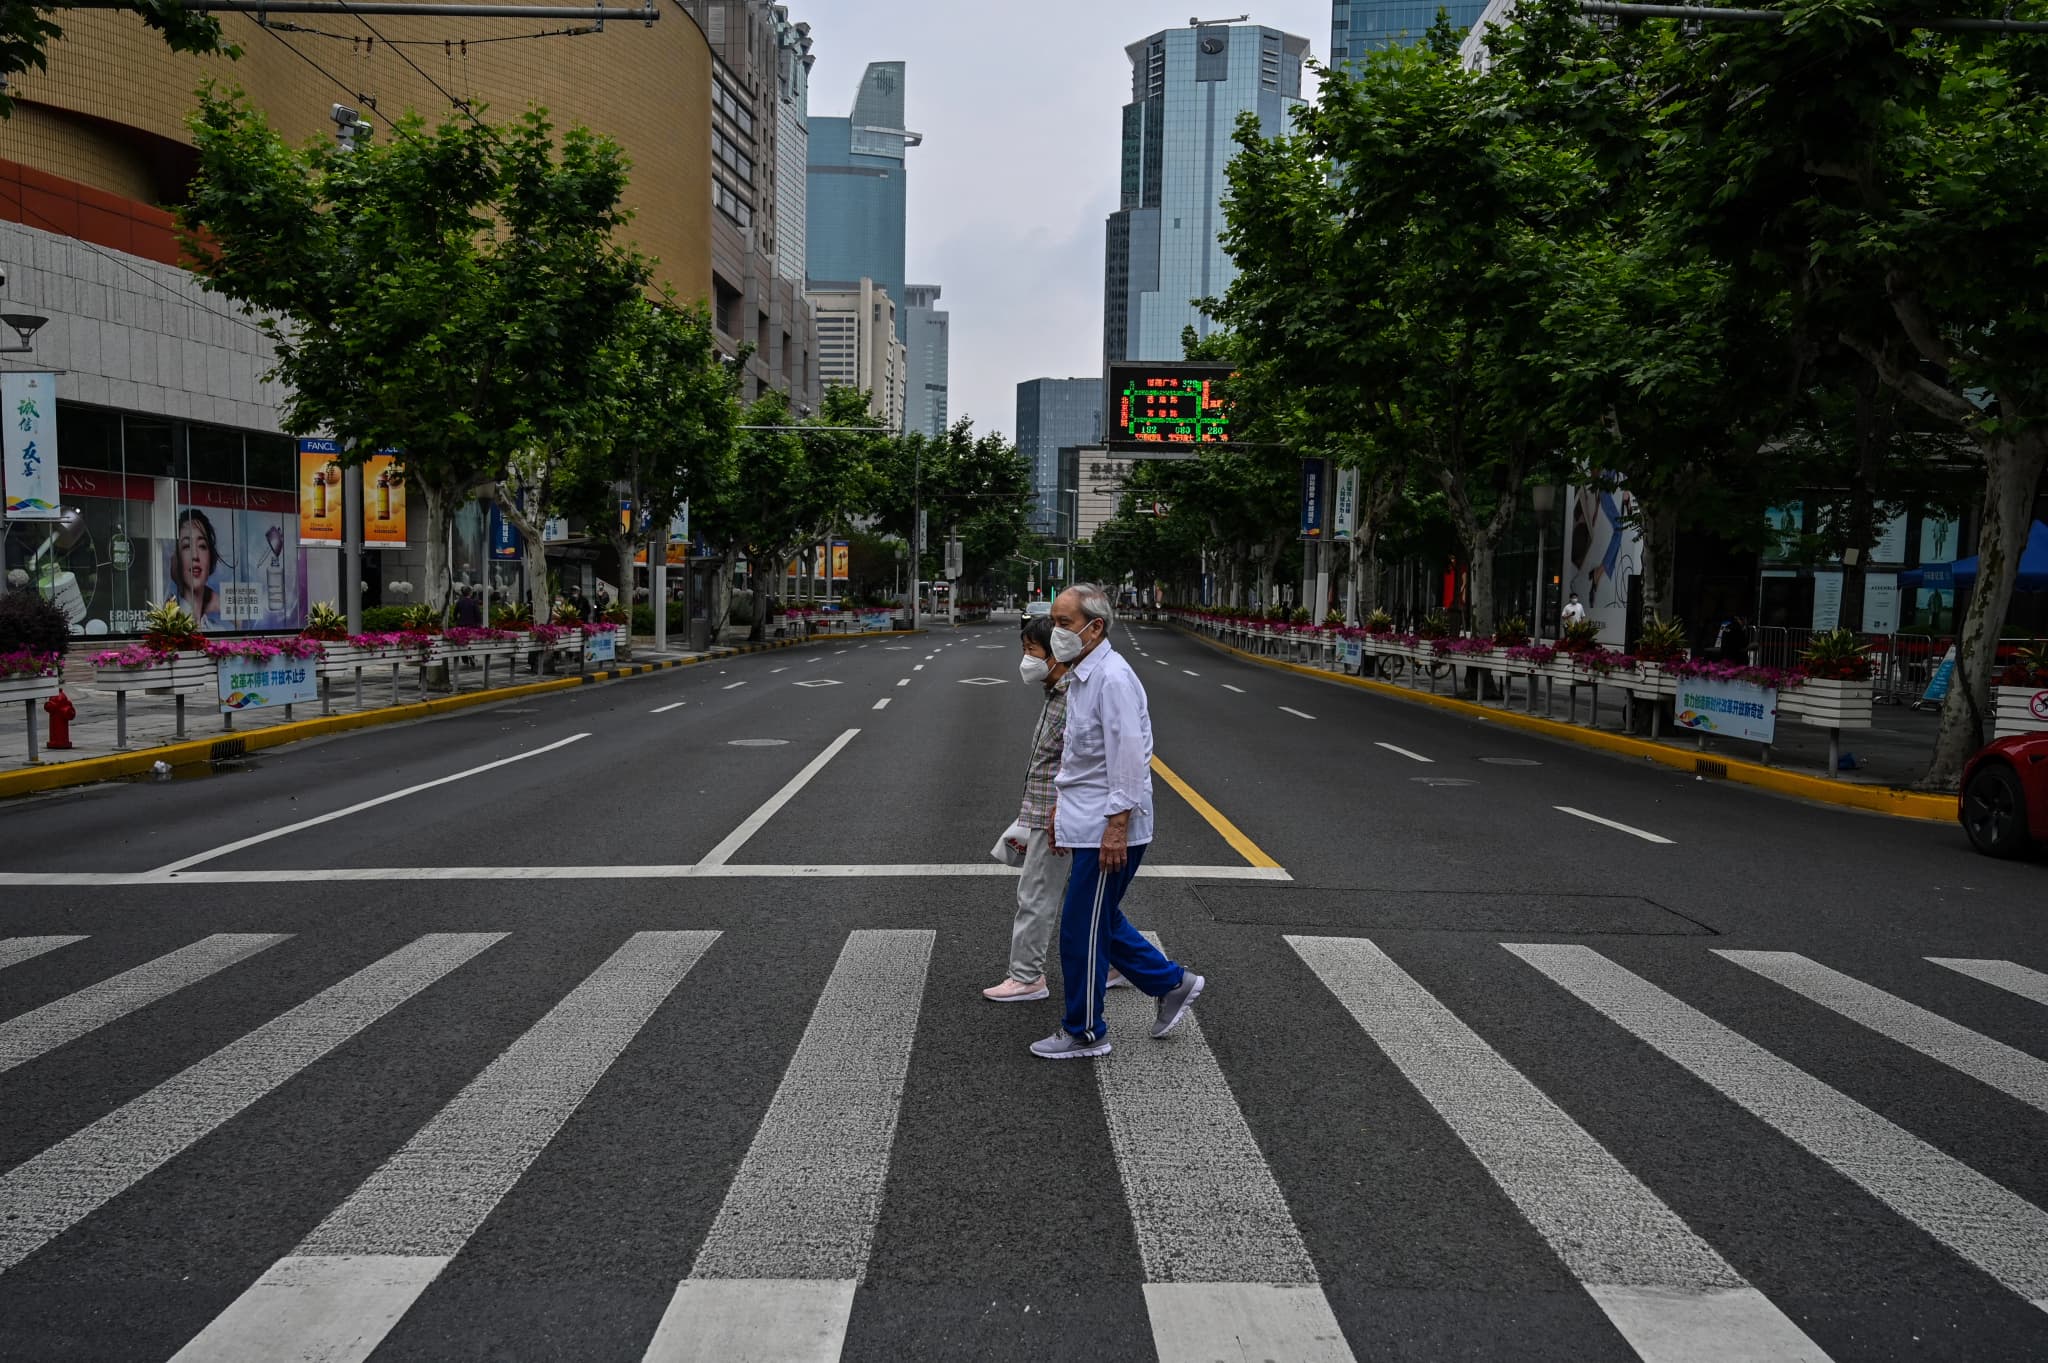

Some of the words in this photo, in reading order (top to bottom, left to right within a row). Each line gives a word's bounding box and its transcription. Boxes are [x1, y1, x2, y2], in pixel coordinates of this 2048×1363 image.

[307, 441, 336, 451] FANCL
[230, 671, 270, 690] 改革不停顿
[271, 668, 306, 686] 开放不止步
